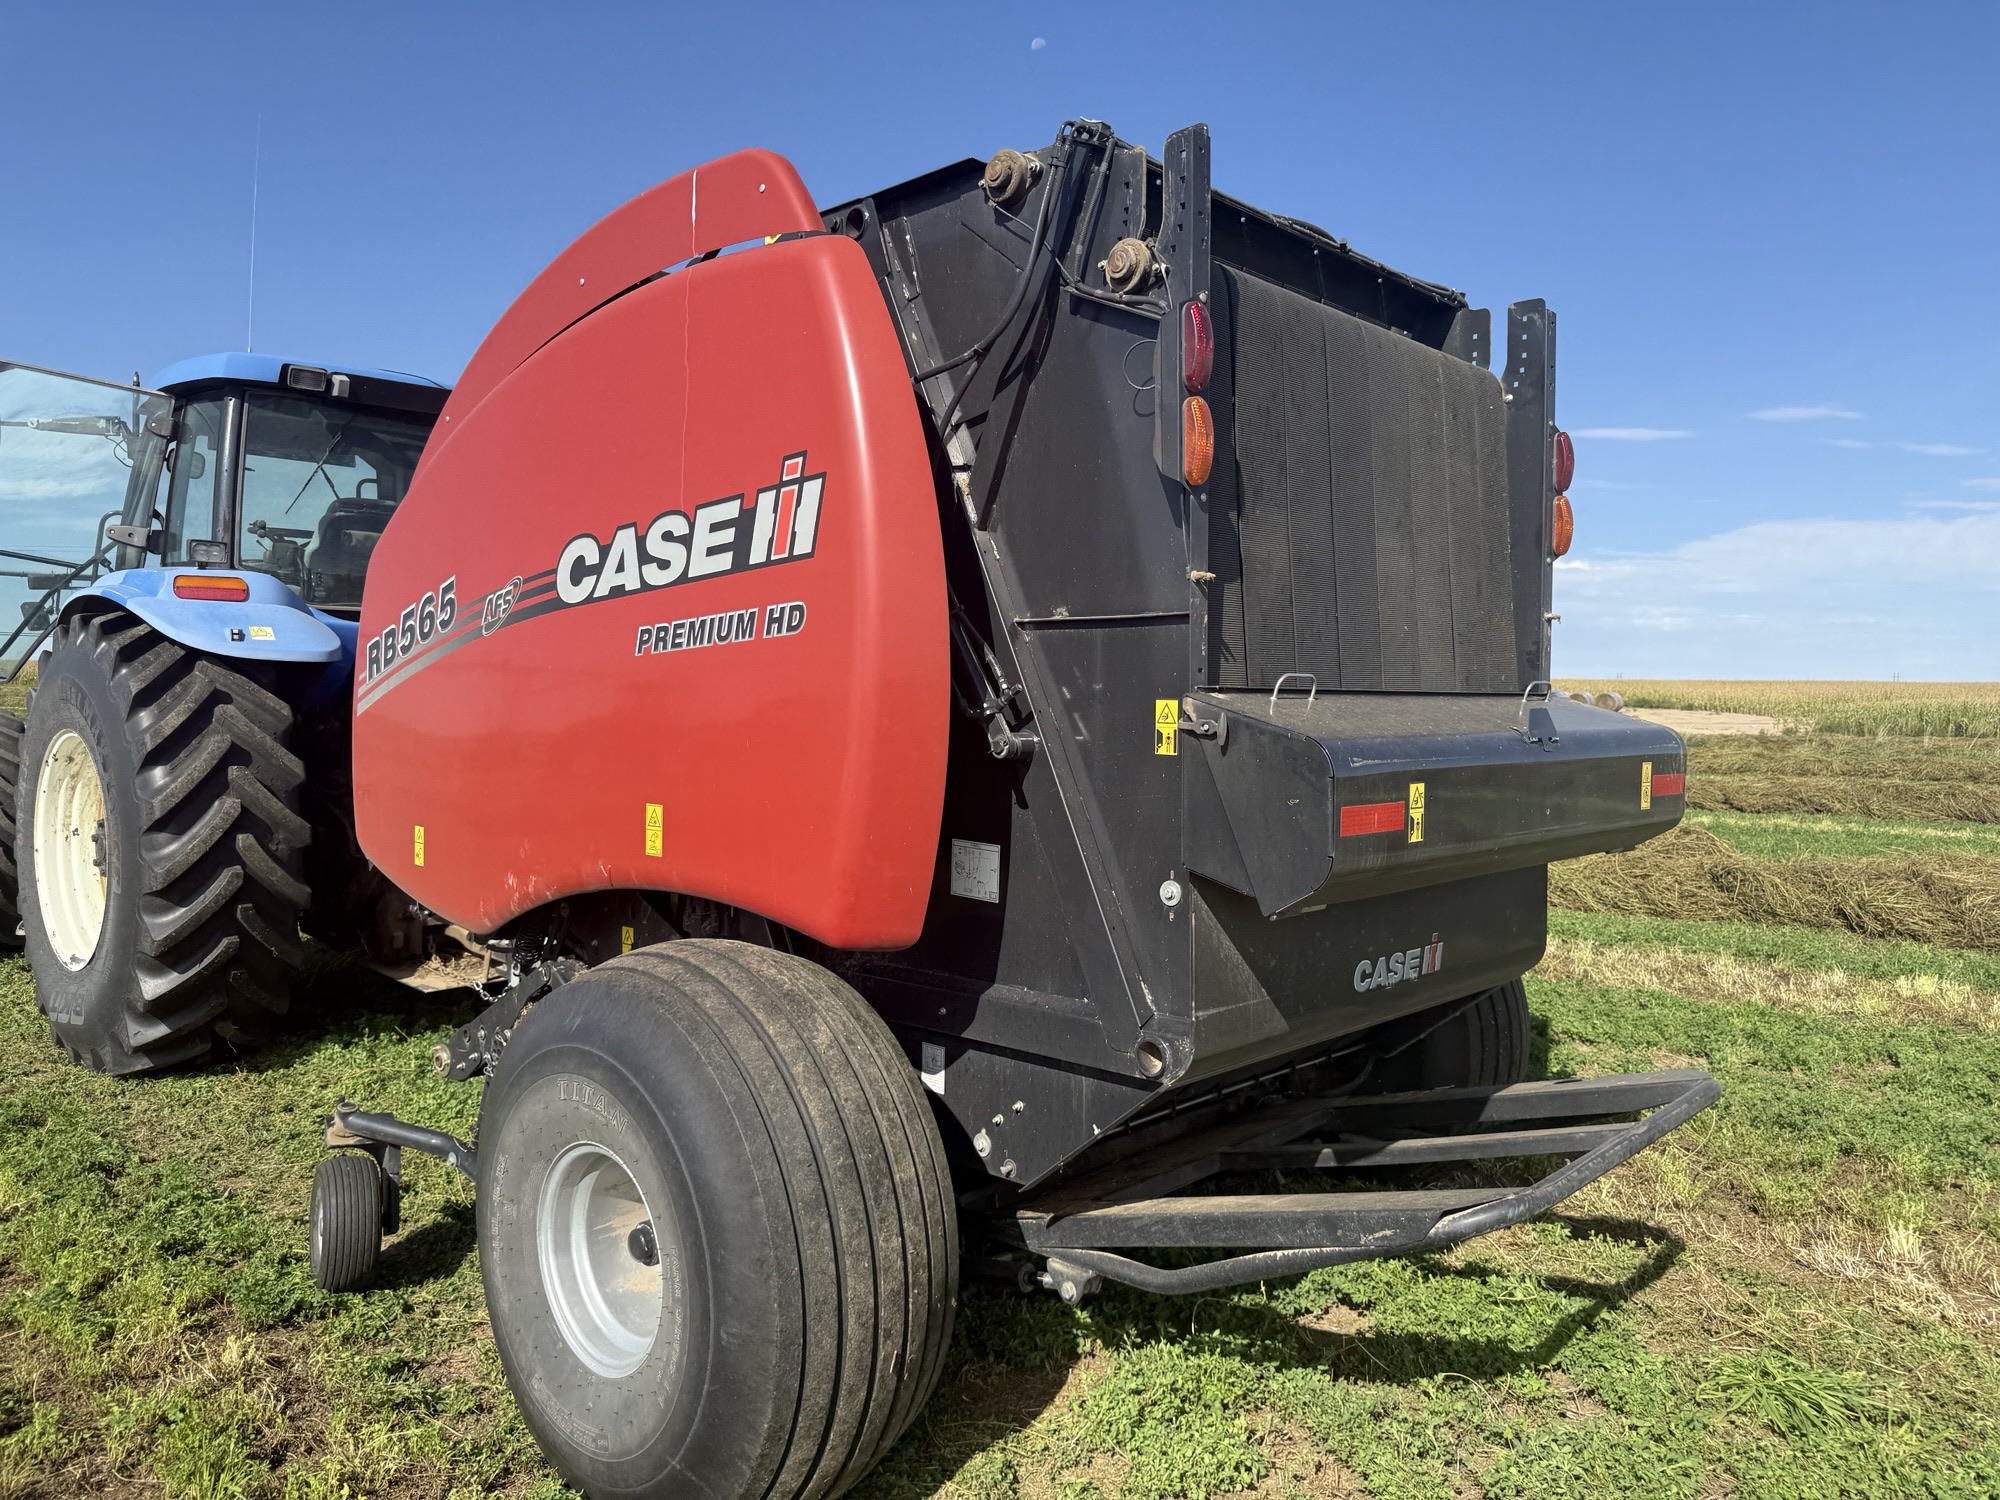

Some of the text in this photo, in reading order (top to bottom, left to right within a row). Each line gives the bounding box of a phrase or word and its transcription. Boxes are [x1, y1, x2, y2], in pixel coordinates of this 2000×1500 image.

[556, 498, 742, 604] CASE
[365, 575, 457, 684] RB565
[481, 584, 514, 626] AFS
[635, 601, 807, 656] PREMIUM HD
[1353, 947, 1421, 992] CASE
[49, 985, 87, 1026] BKT
[556, 1077, 629, 1134] TITAN
